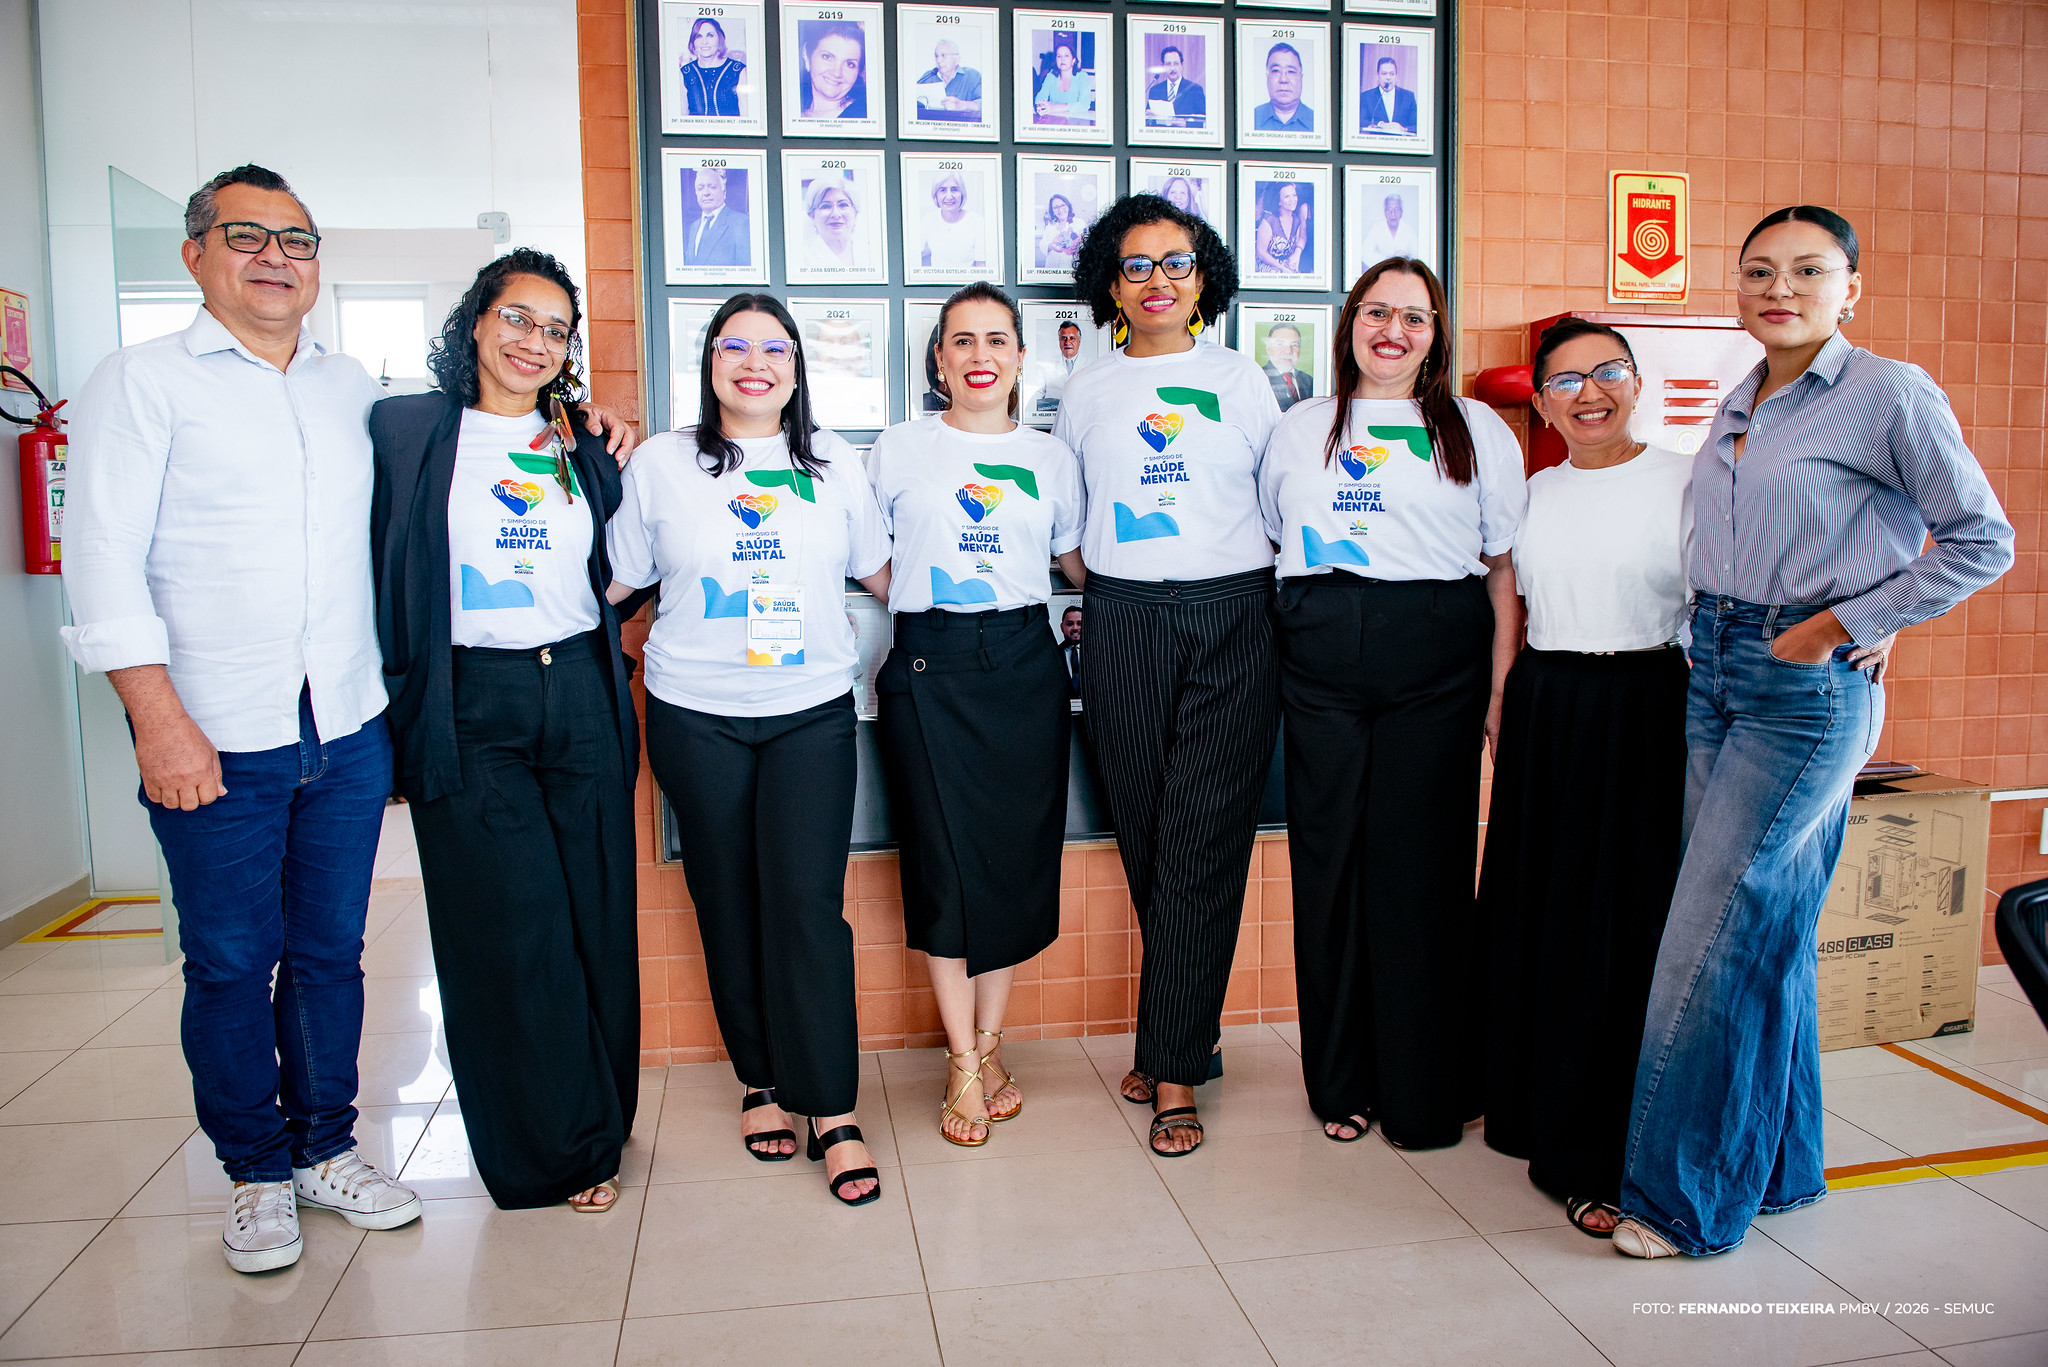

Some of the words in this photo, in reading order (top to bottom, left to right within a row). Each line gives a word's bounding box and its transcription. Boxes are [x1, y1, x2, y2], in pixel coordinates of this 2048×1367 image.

[698, 7, 724, 16] 2019
[818, 11, 843, 19] 2019
[936, 15, 960, 24] 2019
[1051, 20, 1075, 28] 2019
[1163, 24, 1186, 33] 2019
[1272, 30, 1295, 38] 2019
[1379, 35, 1400, 44] 2019
[701, 159, 726, 167] 2020
[821, 160, 846, 169] 2020
[938, 162, 963, 170] 2020
[1054, 164, 1077, 172] 2020
[1168, 168, 1191, 176] 2020
[1274, 171, 1296, 179] 2020
[1632, 198, 1671, 209] HIDRANTE
[1144, 461, 1185, 474] SAÚDE
[1140, 472, 1190, 485] MENTAL
[1337, 489, 1381, 501] SAÚDE
[1332, 502, 1386, 512] MENTAL
[500, 525, 548, 538] SAÚDE
[961, 531, 1000, 543] SAÚDE
[496, 538, 552, 550] MENTAL
[736, 537, 780, 550] SAÚDE
[959, 543, 1003, 554] MENTAL
[732, 550, 785, 562] MENTAL
[1848, 934, 1892, 951] GLASS
